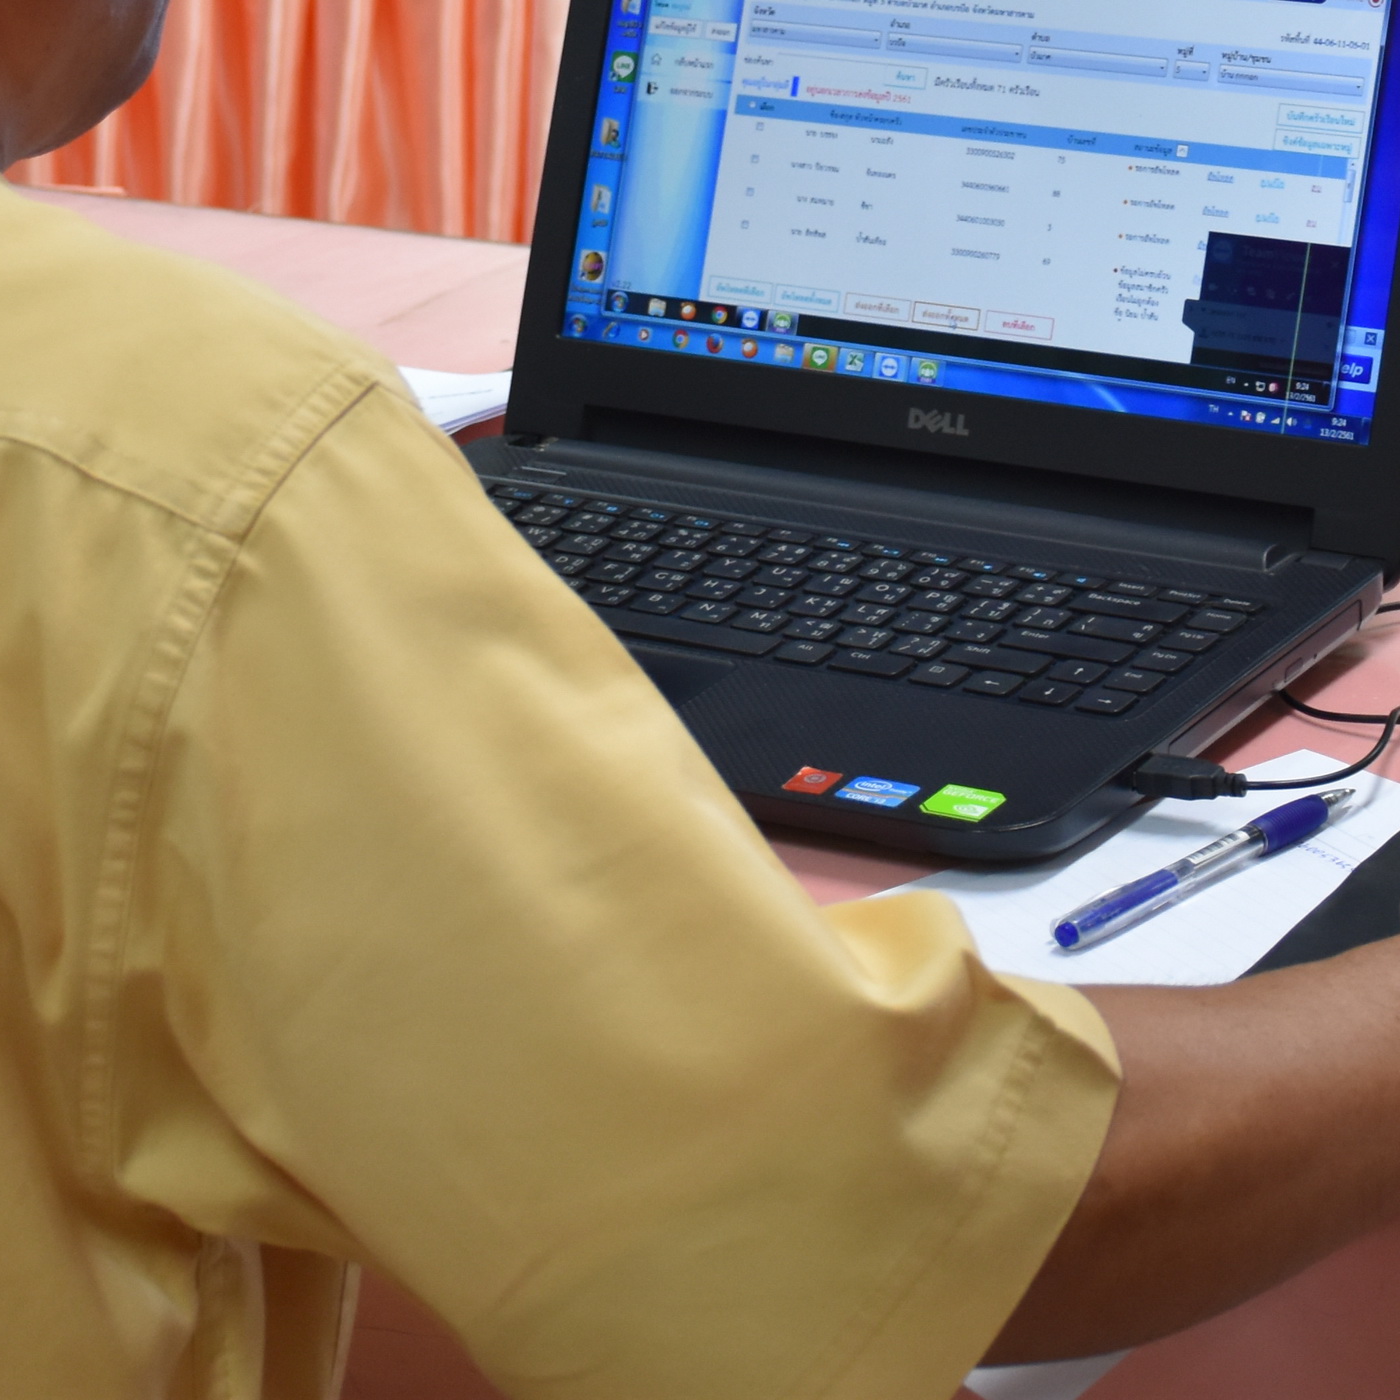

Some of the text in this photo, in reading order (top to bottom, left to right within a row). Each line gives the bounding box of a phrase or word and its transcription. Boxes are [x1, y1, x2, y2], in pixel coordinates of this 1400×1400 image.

[1340, 360, 1364, 378] elp
[1208, 404, 1219, 414] TH
[907, 407, 970, 436] DELL
[1331, 417, 1347, 428] 9:24
[1319, 428, 1355, 441] 13/2/2561
[1117, 581, 1146, 592] Insert
[1087, 592, 1143, 608] Backspace
[1204, 611, 1233, 621] Home
[1020, 629, 1050, 641] Enter
[797, 643, 814, 652] Alt
[964, 644, 992, 656] Shift
[850, 651, 872, 661] Ctrl
[1123, 670, 1144, 680] End
[861, 780, 885, 790] intel
